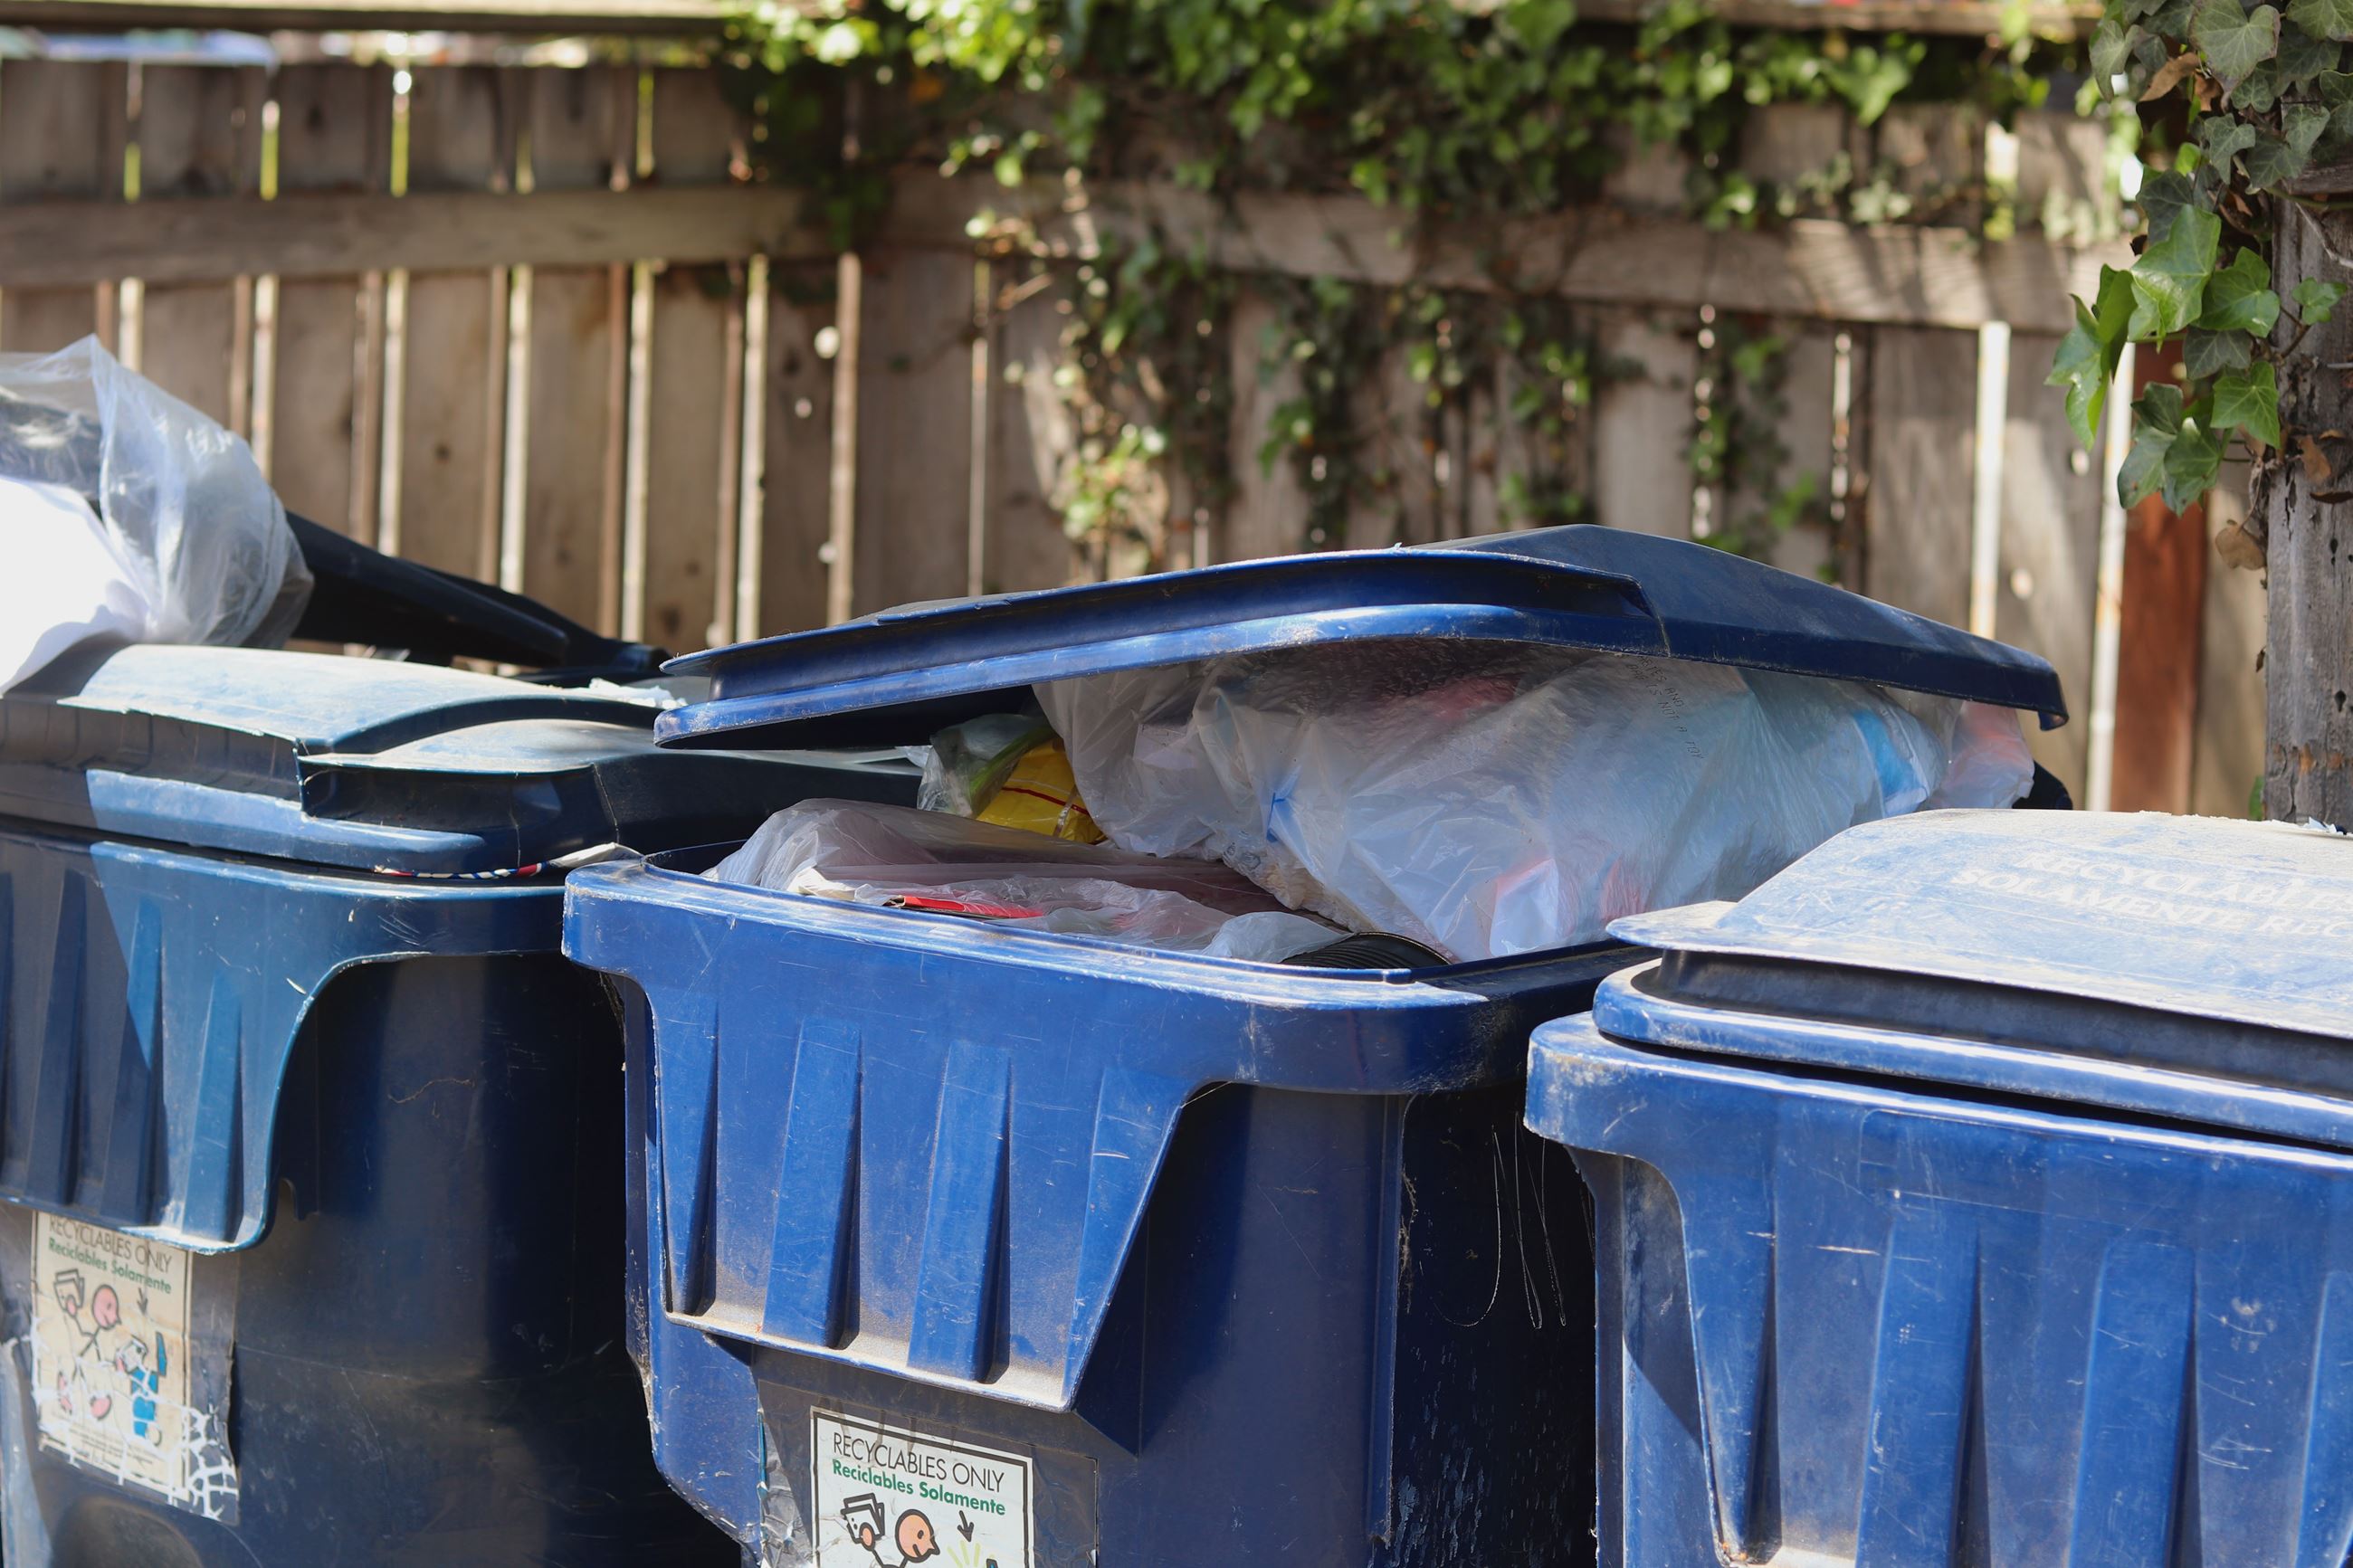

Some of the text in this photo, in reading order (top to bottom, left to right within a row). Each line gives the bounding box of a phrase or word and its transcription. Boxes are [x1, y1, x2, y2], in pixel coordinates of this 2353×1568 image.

[1658, 701, 1680, 720] NOT
[1950, 868, 2255, 934] SOLAMENTE
[48, 1237, 172, 1294] Reciclables Solamente
[49, 1214, 173, 1274] RECYCLABLES ONLY
[832, 1459, 1006, 1516] Reciclables Solamente
[833, 1431, 1005, 1494] RECYCLABLES ONLY
